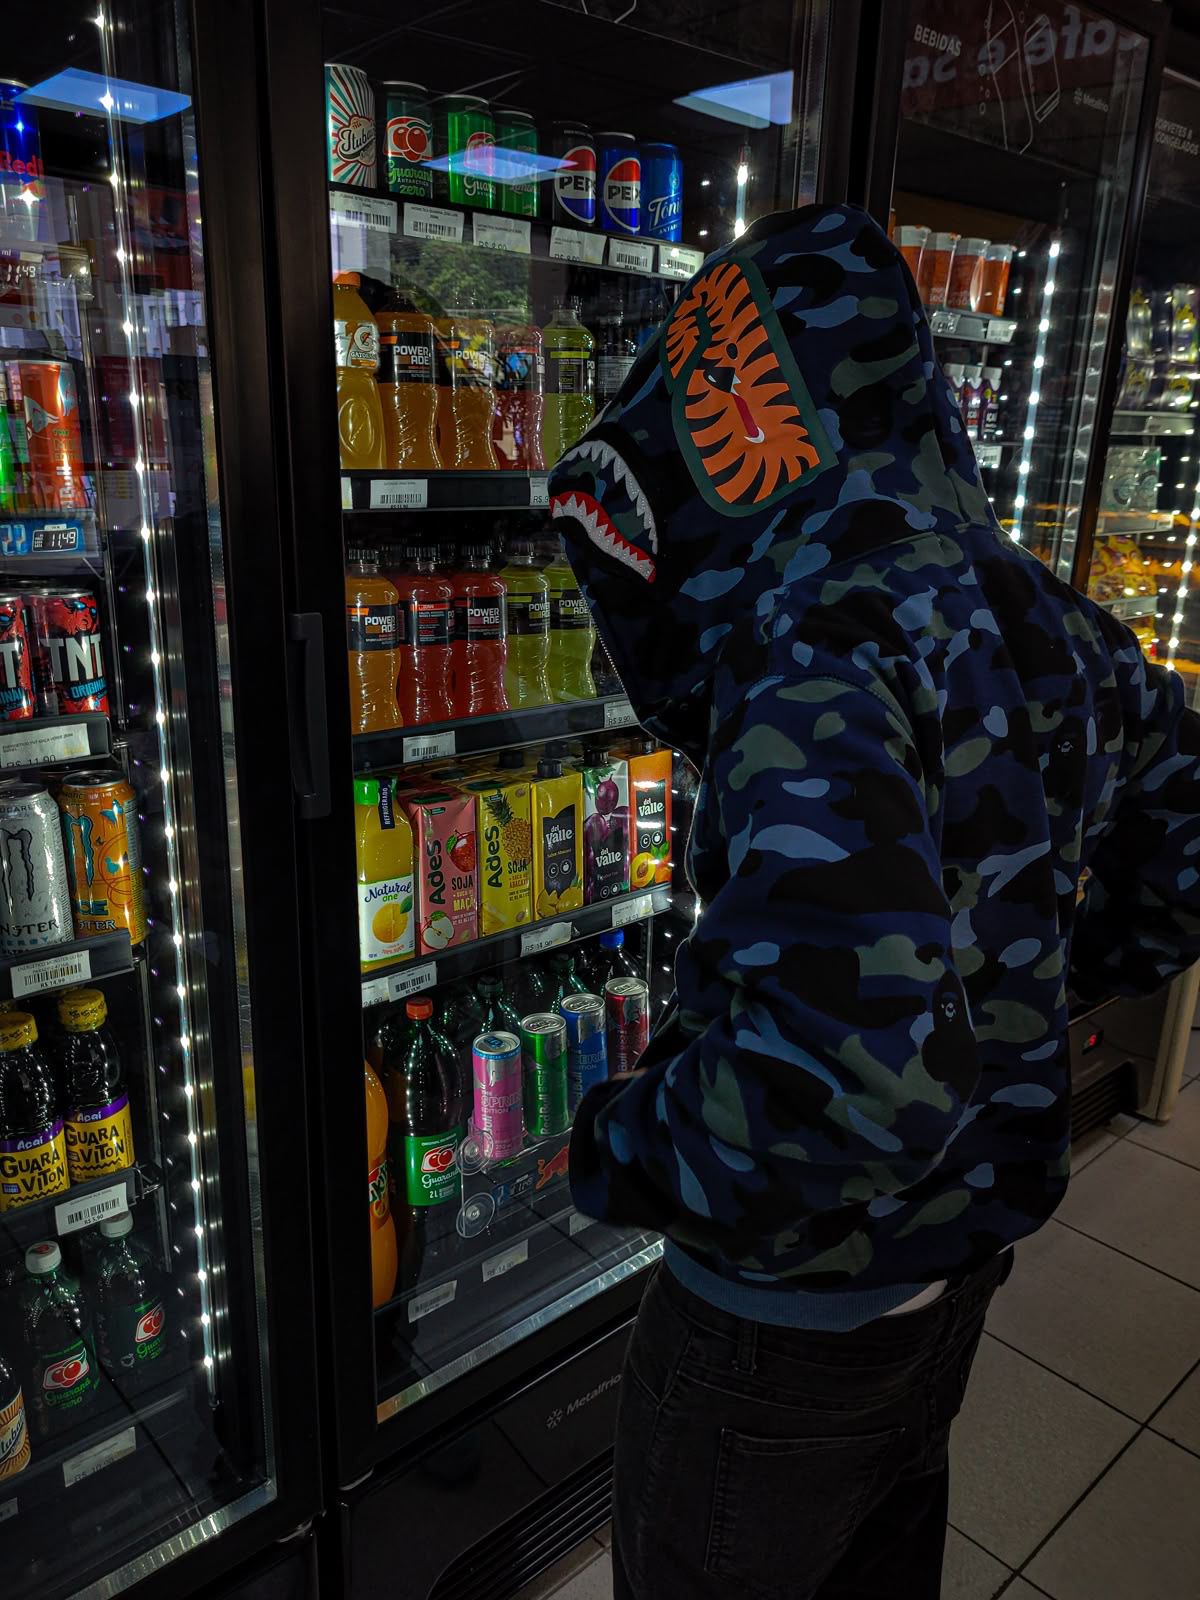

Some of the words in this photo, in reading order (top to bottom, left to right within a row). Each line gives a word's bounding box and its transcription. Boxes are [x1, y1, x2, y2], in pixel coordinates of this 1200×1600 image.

[913, 24, 962, 57] BEBIDAS
[399, 184, 426, 197] zero
[51, 531, 76, 549] 11,49
[468, 607, 499, 618] POWER
[484, 616, 500, 625] ADE
[41, 633, 104, 683] TNT
[638, 801, 665, 818] Valle
[546, 828, 574, 847] Valle
[551, 825, 559, 833] del
[487, 825, 503, 888] AdeS
[596, 851, 623, 868] Valle
[429, 839, 446, 905] AdeS
[508, 859, 530, 875] SOJA
[365, 881, 413, 903] Natural
[451, 875, 474, 891] SOJA
[382, 894, 399, 903] one
[65, 1125, 120, 1147] GUARA
[0, 1148, 60, 1179] GUARA
[567, 1374, 623, 1415] Metalfrio
